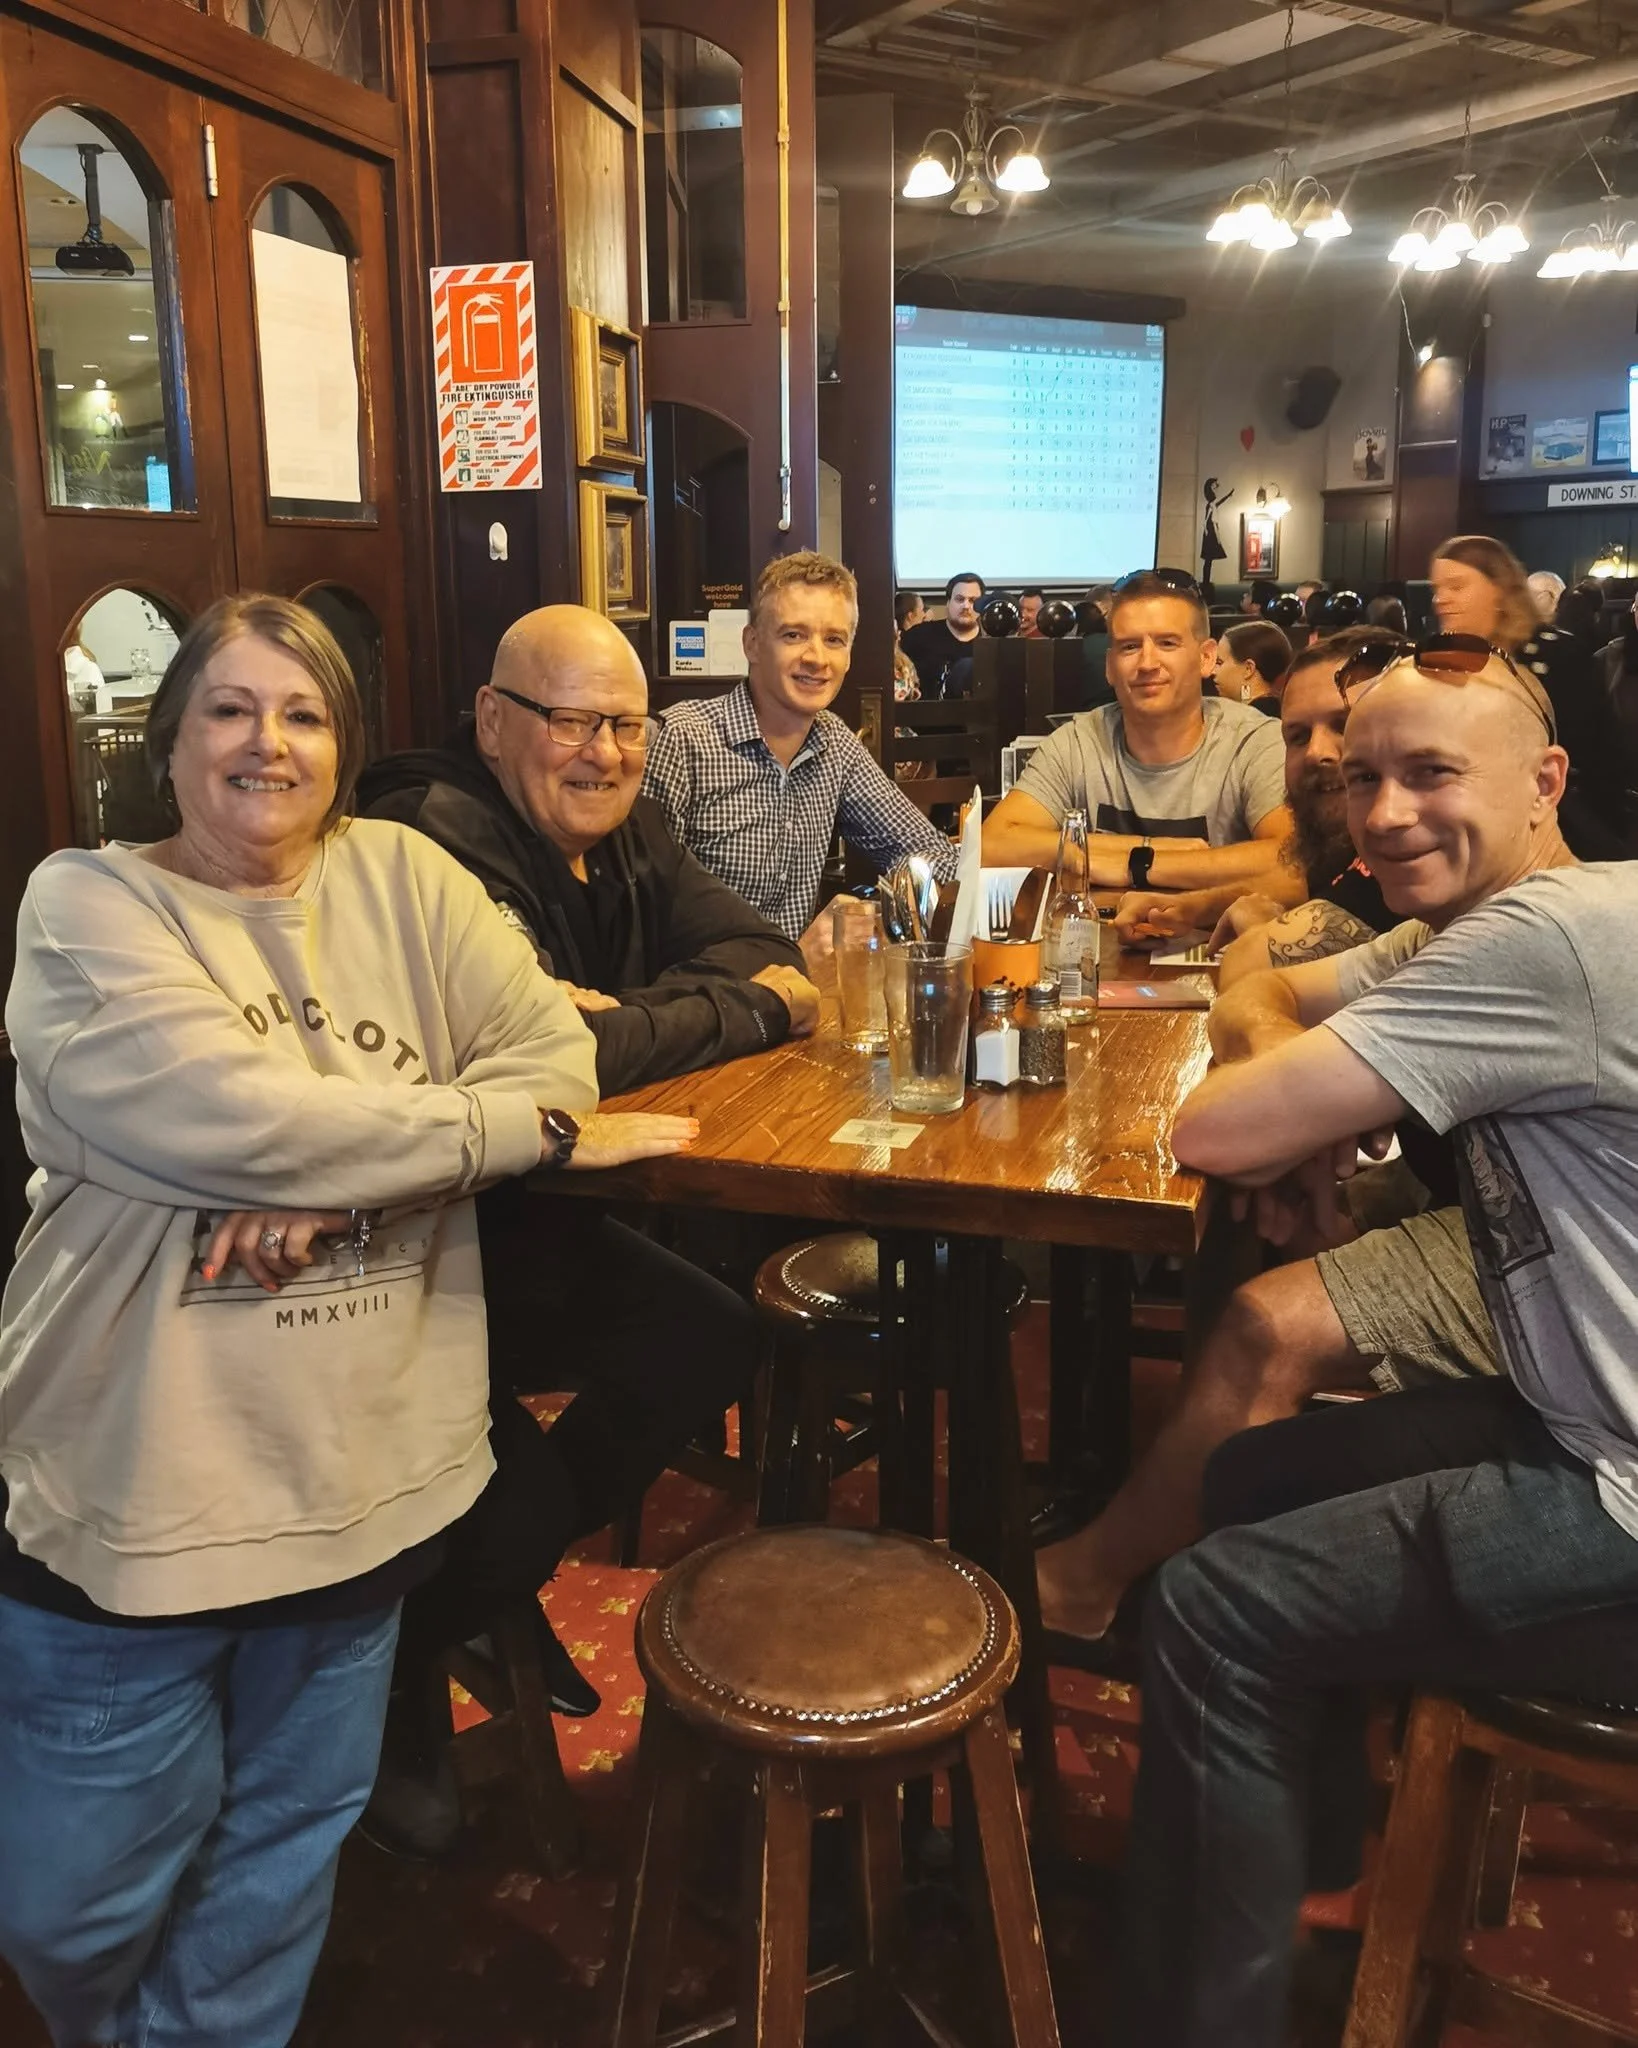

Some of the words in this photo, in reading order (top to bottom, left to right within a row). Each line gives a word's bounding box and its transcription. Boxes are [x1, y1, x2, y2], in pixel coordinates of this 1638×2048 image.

[490, 382, 521, 390] POWDER
[442, 393, 462, 403] FIRE
[464, 389, 534, 401] EXTINGUISHER
[1561, 486, 1614, 502] DOWNING
[1620, 485, 1637, 499] ST.
[701, 584, 743, 592] SuperGold
[276, 1293, 389, 1328] MMXVIII
